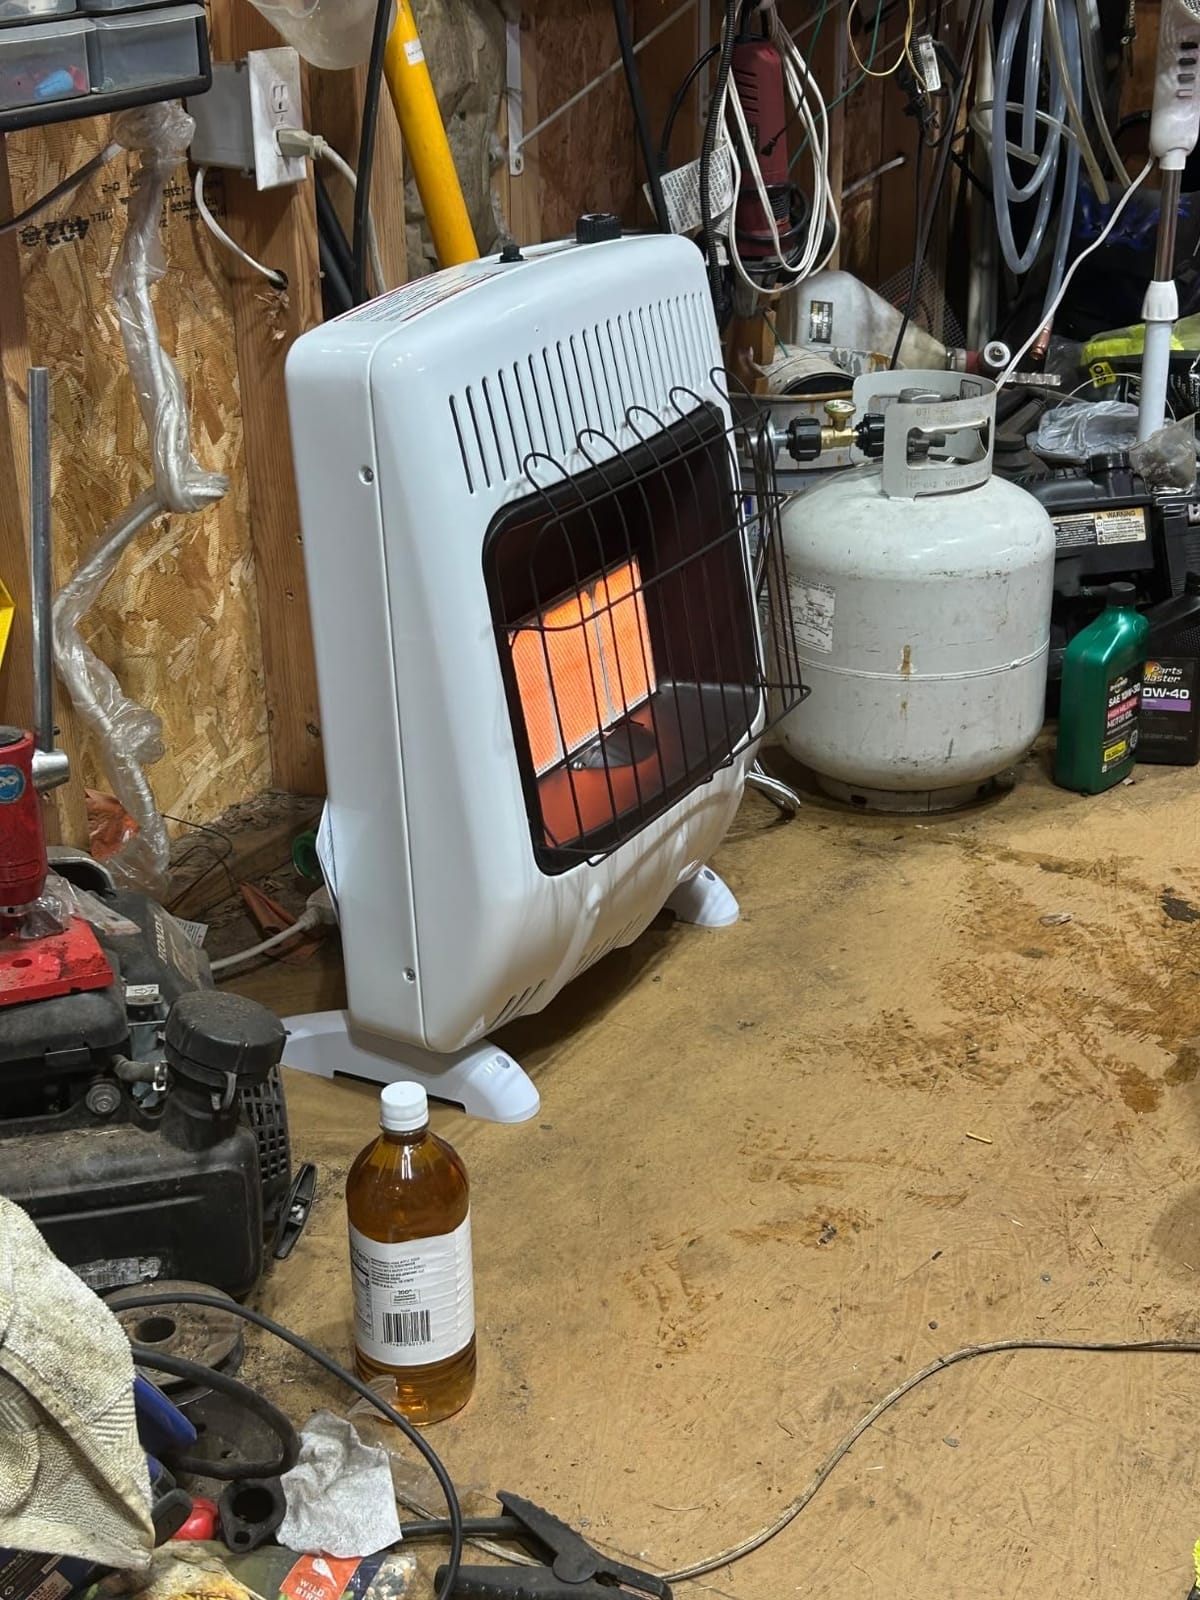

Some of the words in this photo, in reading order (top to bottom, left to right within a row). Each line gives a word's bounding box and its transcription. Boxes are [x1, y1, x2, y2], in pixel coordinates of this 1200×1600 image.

[1106, 510, 1136, 519] WARNING
[1152, 663, 1183, 676] Parts
[1144, 674, 1181, 683] Master
[1109, 694, 1120, 707] SAE
[300, 1579, 324, 1597] WILD
